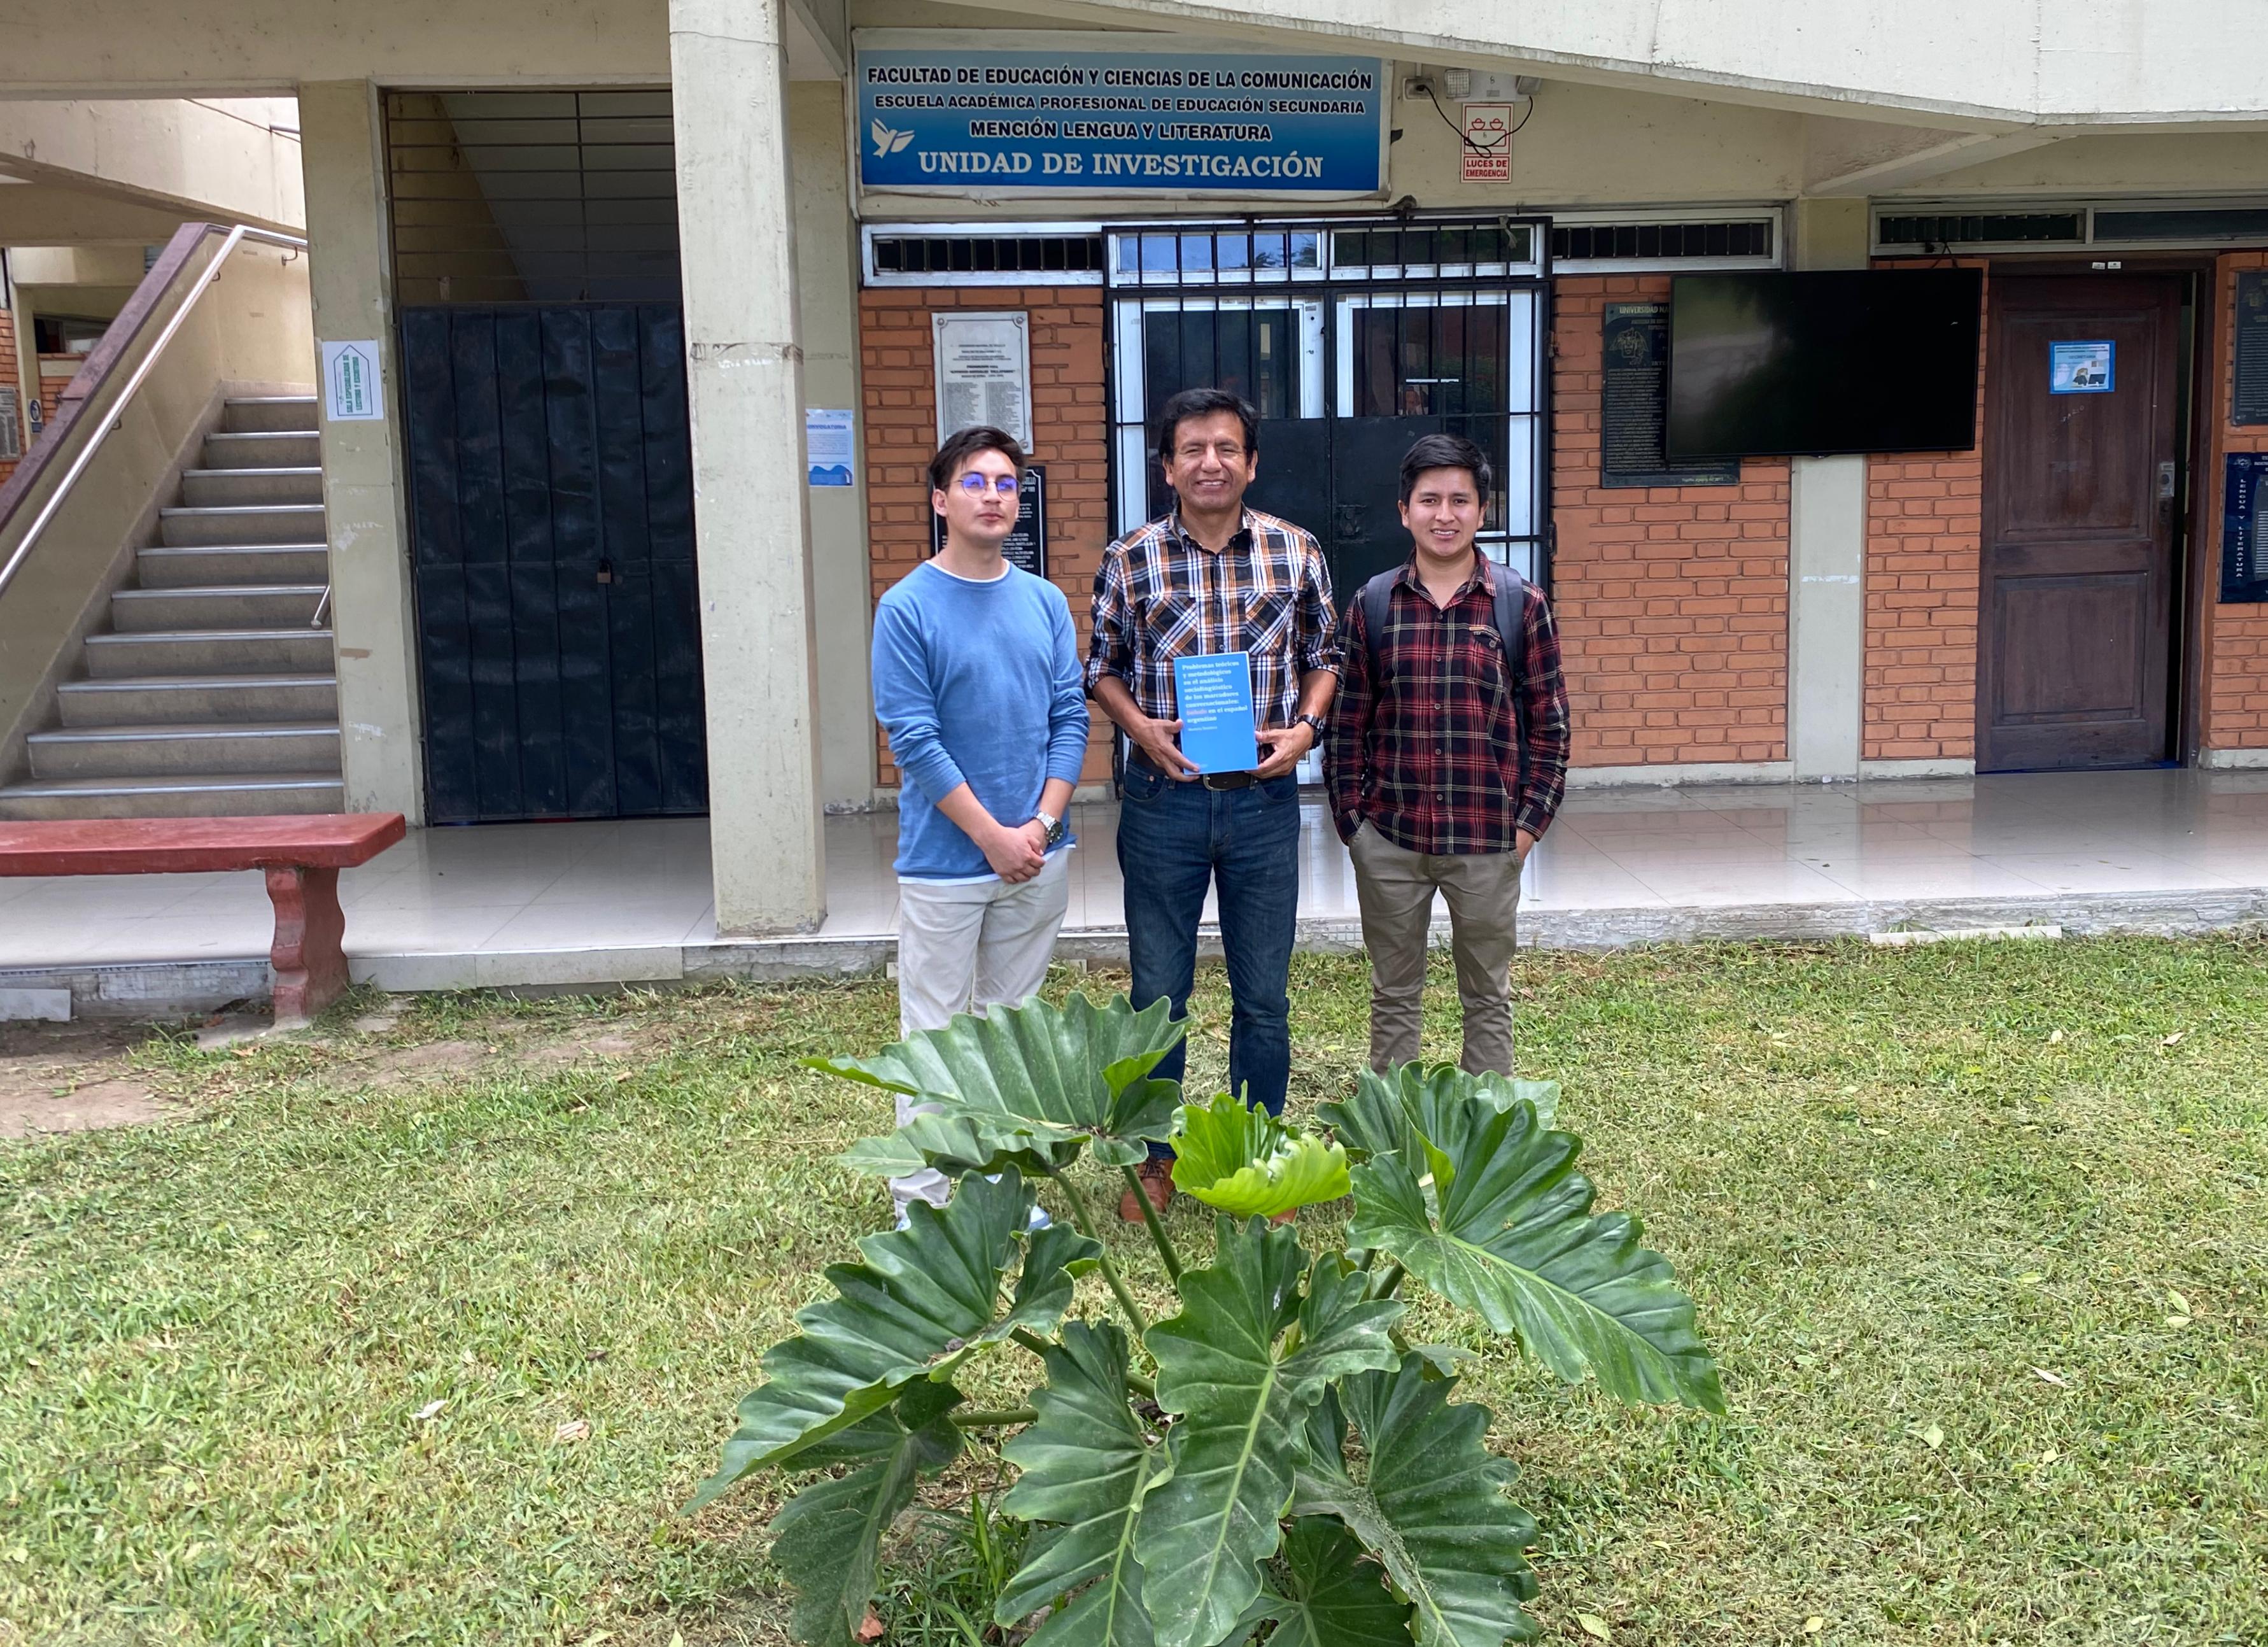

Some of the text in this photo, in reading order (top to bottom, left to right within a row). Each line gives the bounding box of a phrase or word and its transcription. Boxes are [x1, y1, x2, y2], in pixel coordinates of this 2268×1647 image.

[868, 65, 1372, 90] FACULTAD DE EDUCACIÓN Y CIENCIAS DE LA COMUNICACIÓN
[875, 92, 1365, 114] ESCUELA ACADÉMICA PROFESIONAL DE EDUCACIÓN SECUNDARIA
[969, 117, 1272, 141] MENCIÓN LENGUA Y LITERATURA
[917, 150, 1324, 178] UNIDAD DE INVESTIGACIÓN
[1465, 169, 1507, 178] EMERGENCIA
[1466, 159, 1507, 167] LUCES DE
[1619, 306, 1658, 314] UNIVERSIDAD
[2236, 526, 2244, 577] LITERATURA
[1224, 705, 1248, 713] español
